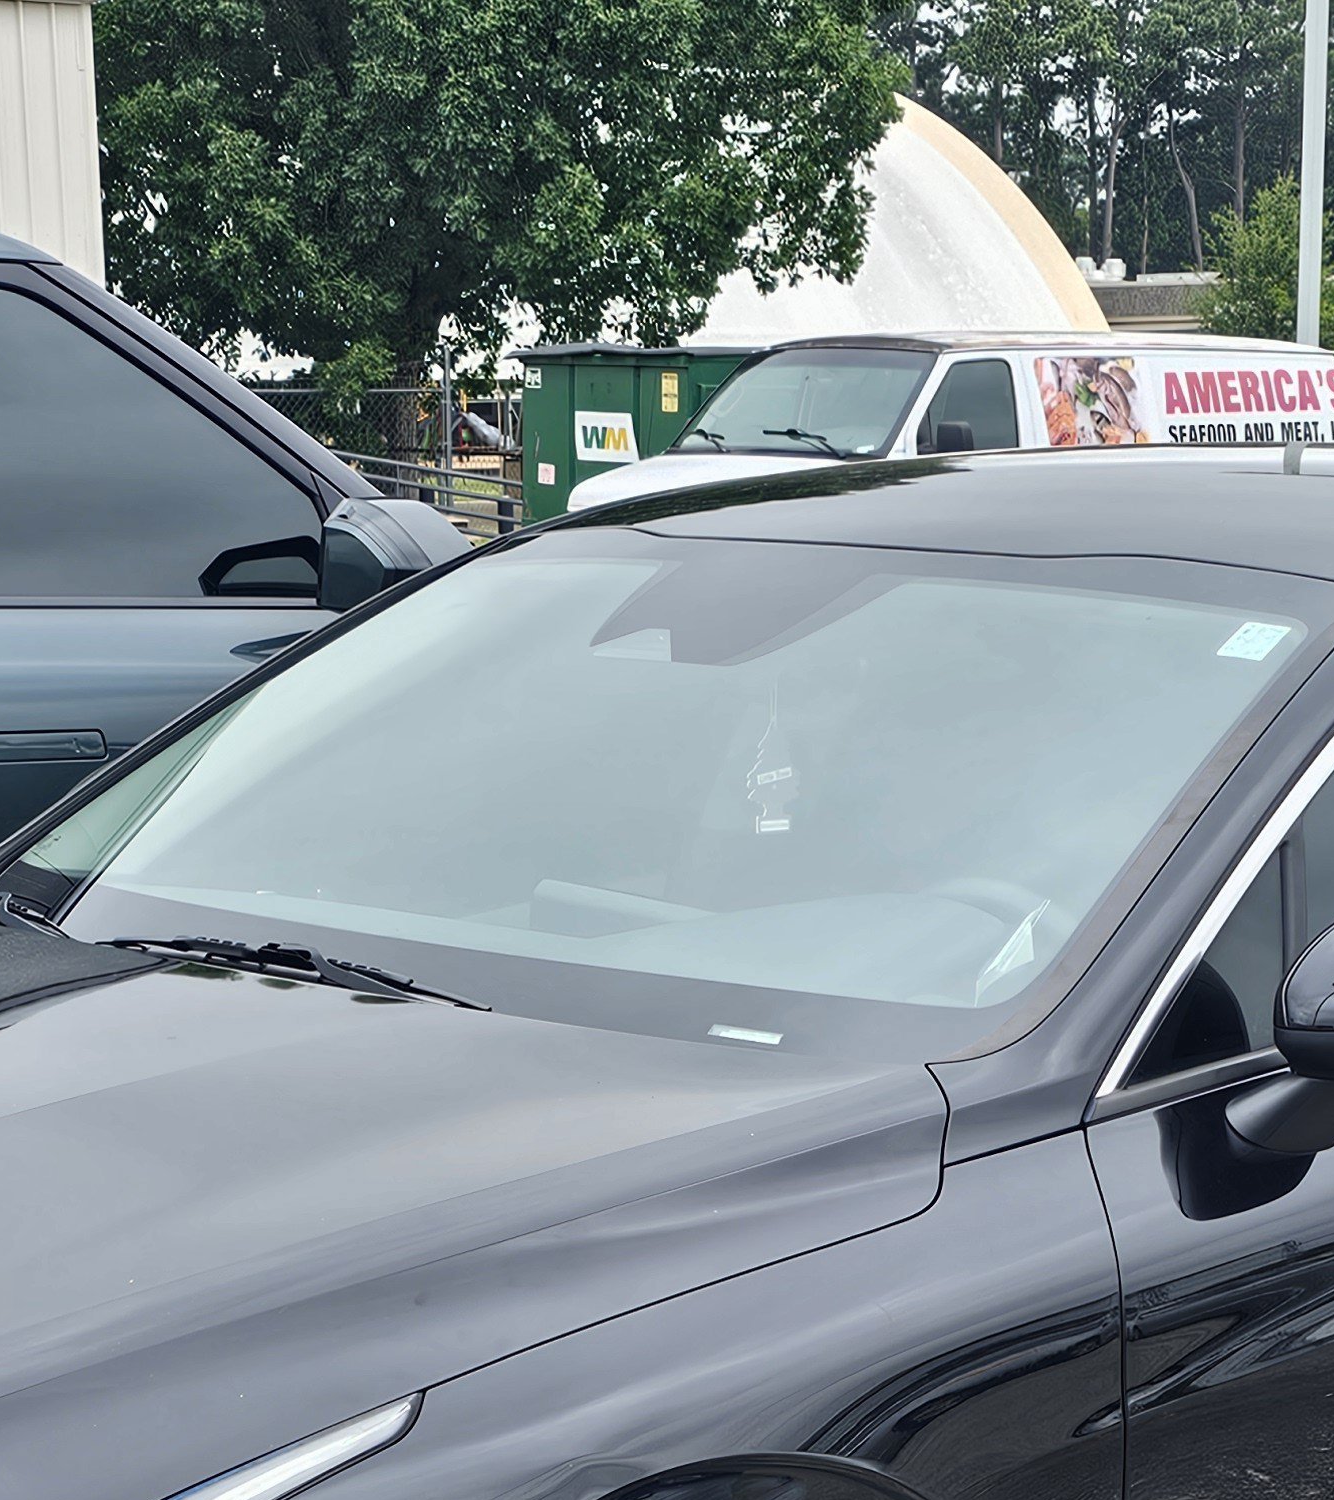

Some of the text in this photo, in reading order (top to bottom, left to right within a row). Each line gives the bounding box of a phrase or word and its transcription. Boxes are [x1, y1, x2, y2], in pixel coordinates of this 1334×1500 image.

[581, 425, 629, 452] WM
[1168, 423, 1237, 443] SEAFOOD
[1244, 422, 1275, 443] AND
[1280, 420, 1325, 442] MEAT,
